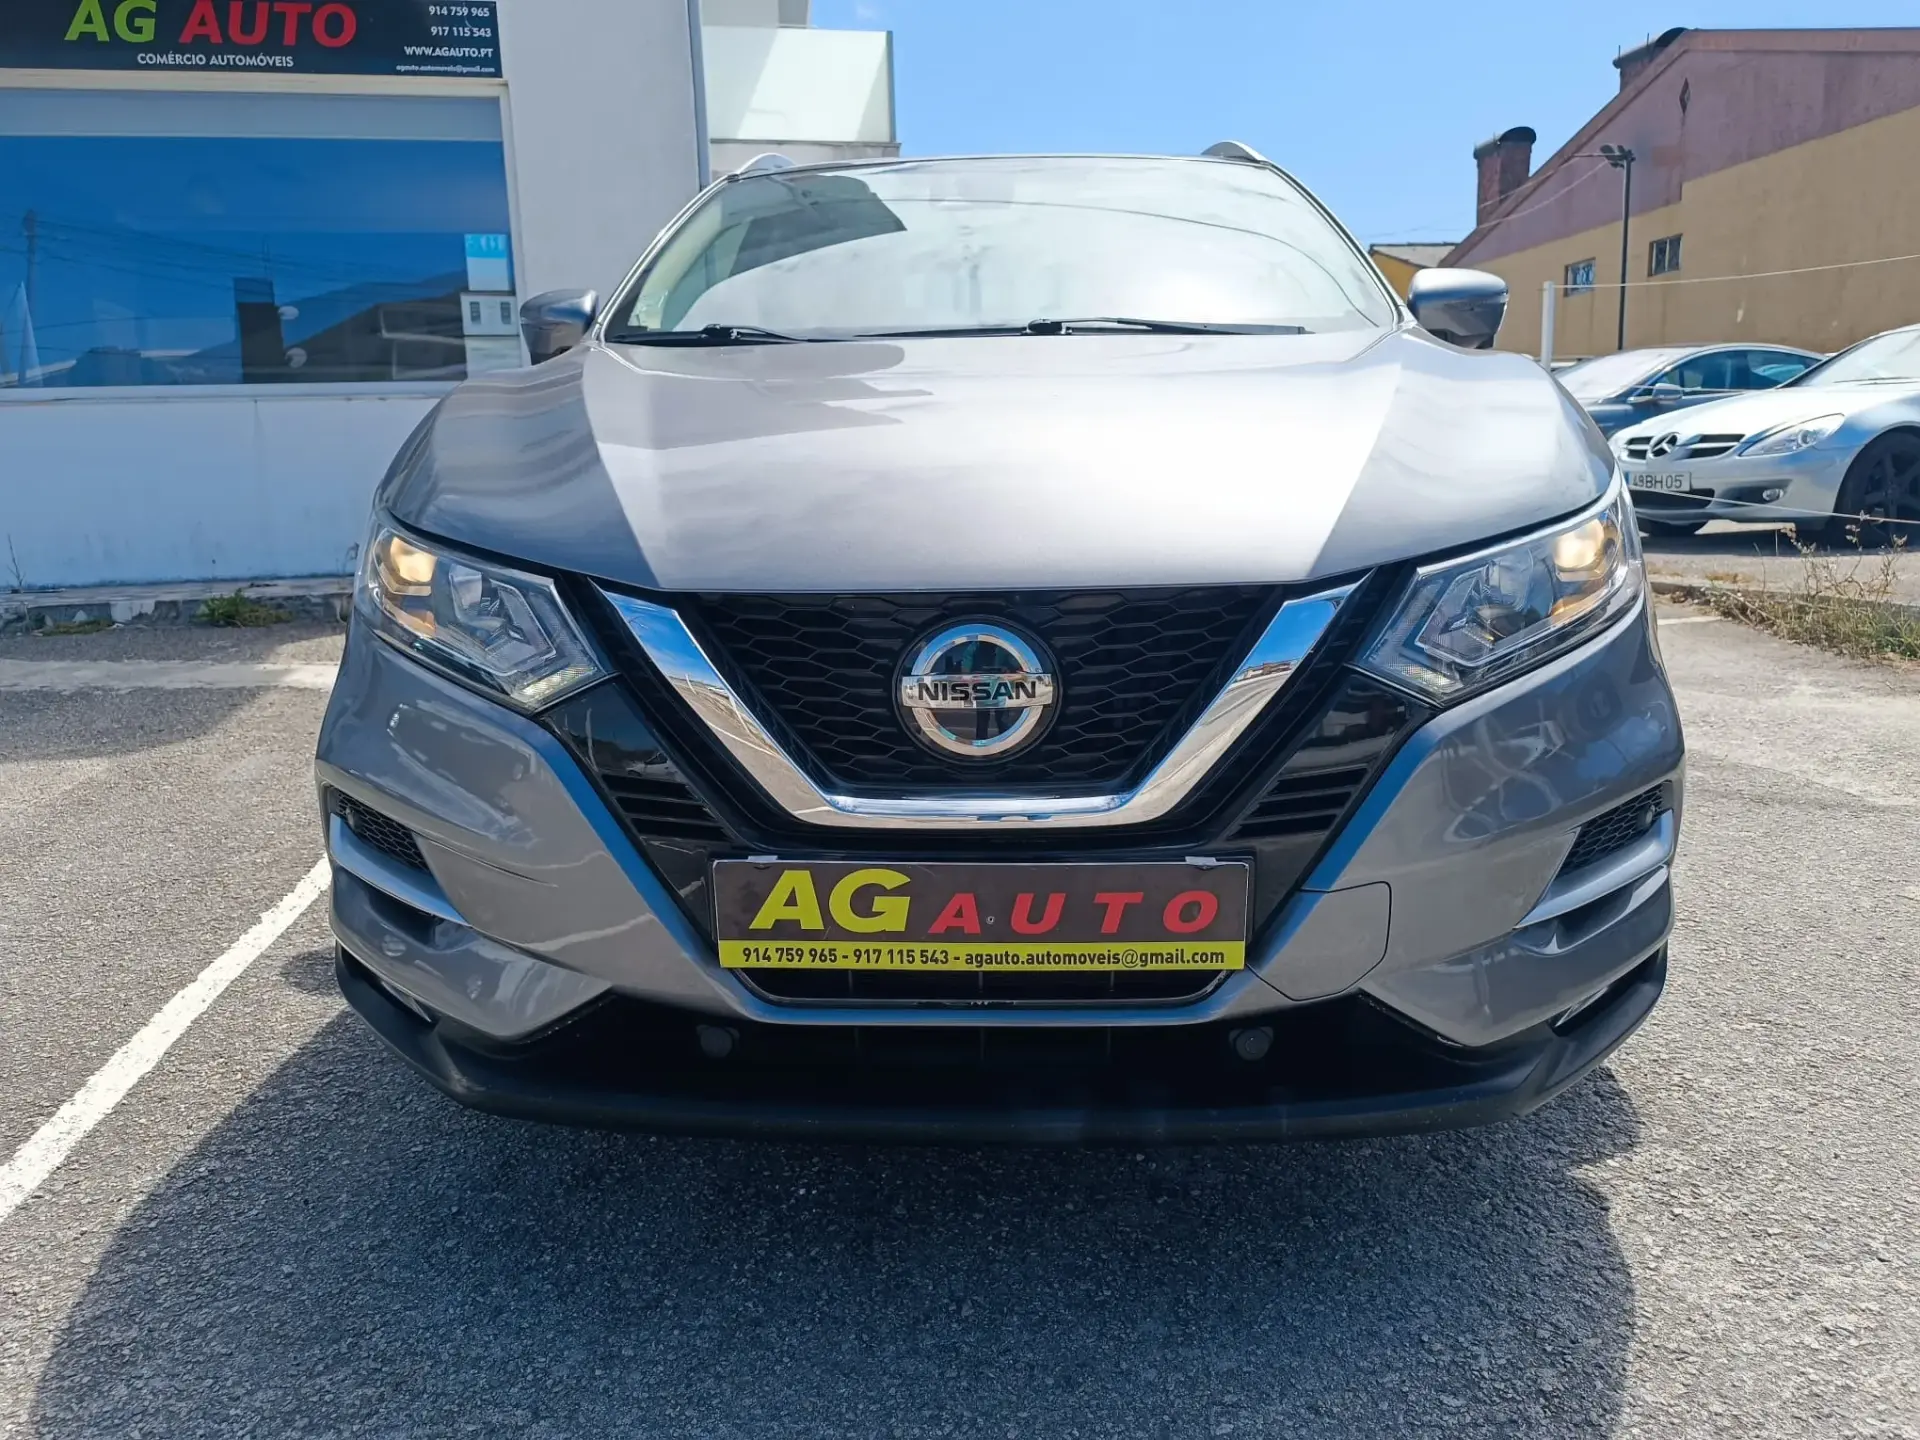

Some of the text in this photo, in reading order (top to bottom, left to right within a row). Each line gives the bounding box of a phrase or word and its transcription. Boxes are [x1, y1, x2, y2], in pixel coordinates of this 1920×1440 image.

[428, 6, 490, 17] 914 759 965
[64, 0, 357, 47] AG AUTO
[430, 26, 492, 37] 917 115 543
[136, 52, 294, 68] COMÉRCIO AUTOMÓVEIS
[404, 46, 493, 58] WWW.AGAUTO.PT
[917, 680, 1037, 701] NISSAN
[749, 869, 1219, 935] AG AUTO
[742, 946, 772, 963] 914
[774, 947, 804, 963] 759
[808, 948, 838, 963] 965
[853, 948, 882, 965] 917
[887, 949, 917, 965] 115
[919, 949, 950, 965] 543
[964, 948, 1226, 969] agauto.automoveis@gmail.com
